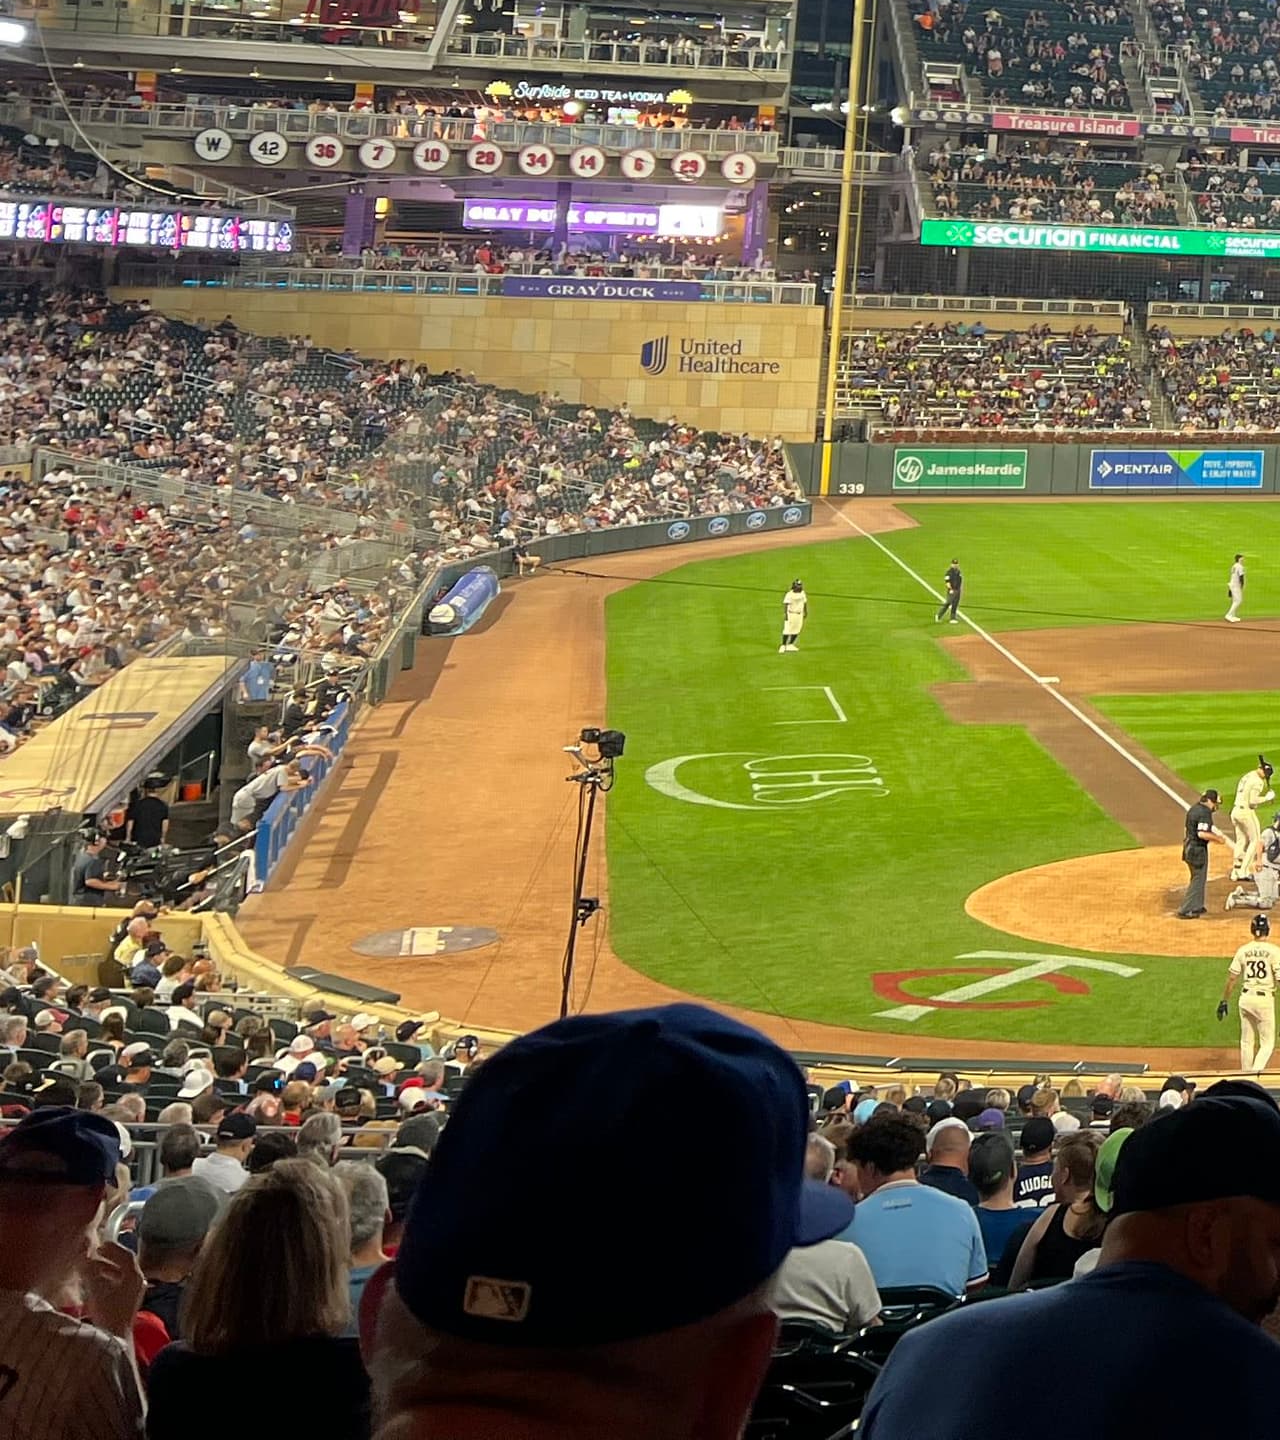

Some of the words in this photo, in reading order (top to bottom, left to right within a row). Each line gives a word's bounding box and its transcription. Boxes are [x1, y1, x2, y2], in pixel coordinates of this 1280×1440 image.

[514, 81, 571, 100] Surfside
[574, 89, 599, 100] ICED
[1009, 116, 1072, 133] Treasure
[1076, 118, 1125, 137] Island
[206, 137, 221, 152] W
[258, 141, 280, 156] 42
[314, 143, 336, 159] 36
[372, 146, 385, 161] 7
[424, 148, 441, 163] 10
[476, 151, 495, 166] 28
[526, 152, 547, 167] 34
[579, 155, 597, 170] 14
[633, 156, 644, 172] 6
[734, 162, 744, 176] 3
[468, 206, 521, 222] GRAY
[584, 209, 657, 227] SPIRITS
[973, 224, 1085, 248] securian
[1088, 232, 1180, 250] FINANCIAL
[547, 284, 600, 298] GRAY
[603, 285, 654, 298] DUCK
[680, 338, 742, 356] United
[679, 356, 780, 375] Healthcare
[926, 462, 1021, 477] JamesHardie
[1113, 464, 1173, 475] PENTAIR
[839, 482, 865, 494] 339
[1246, 960, 1267, 979] 38
